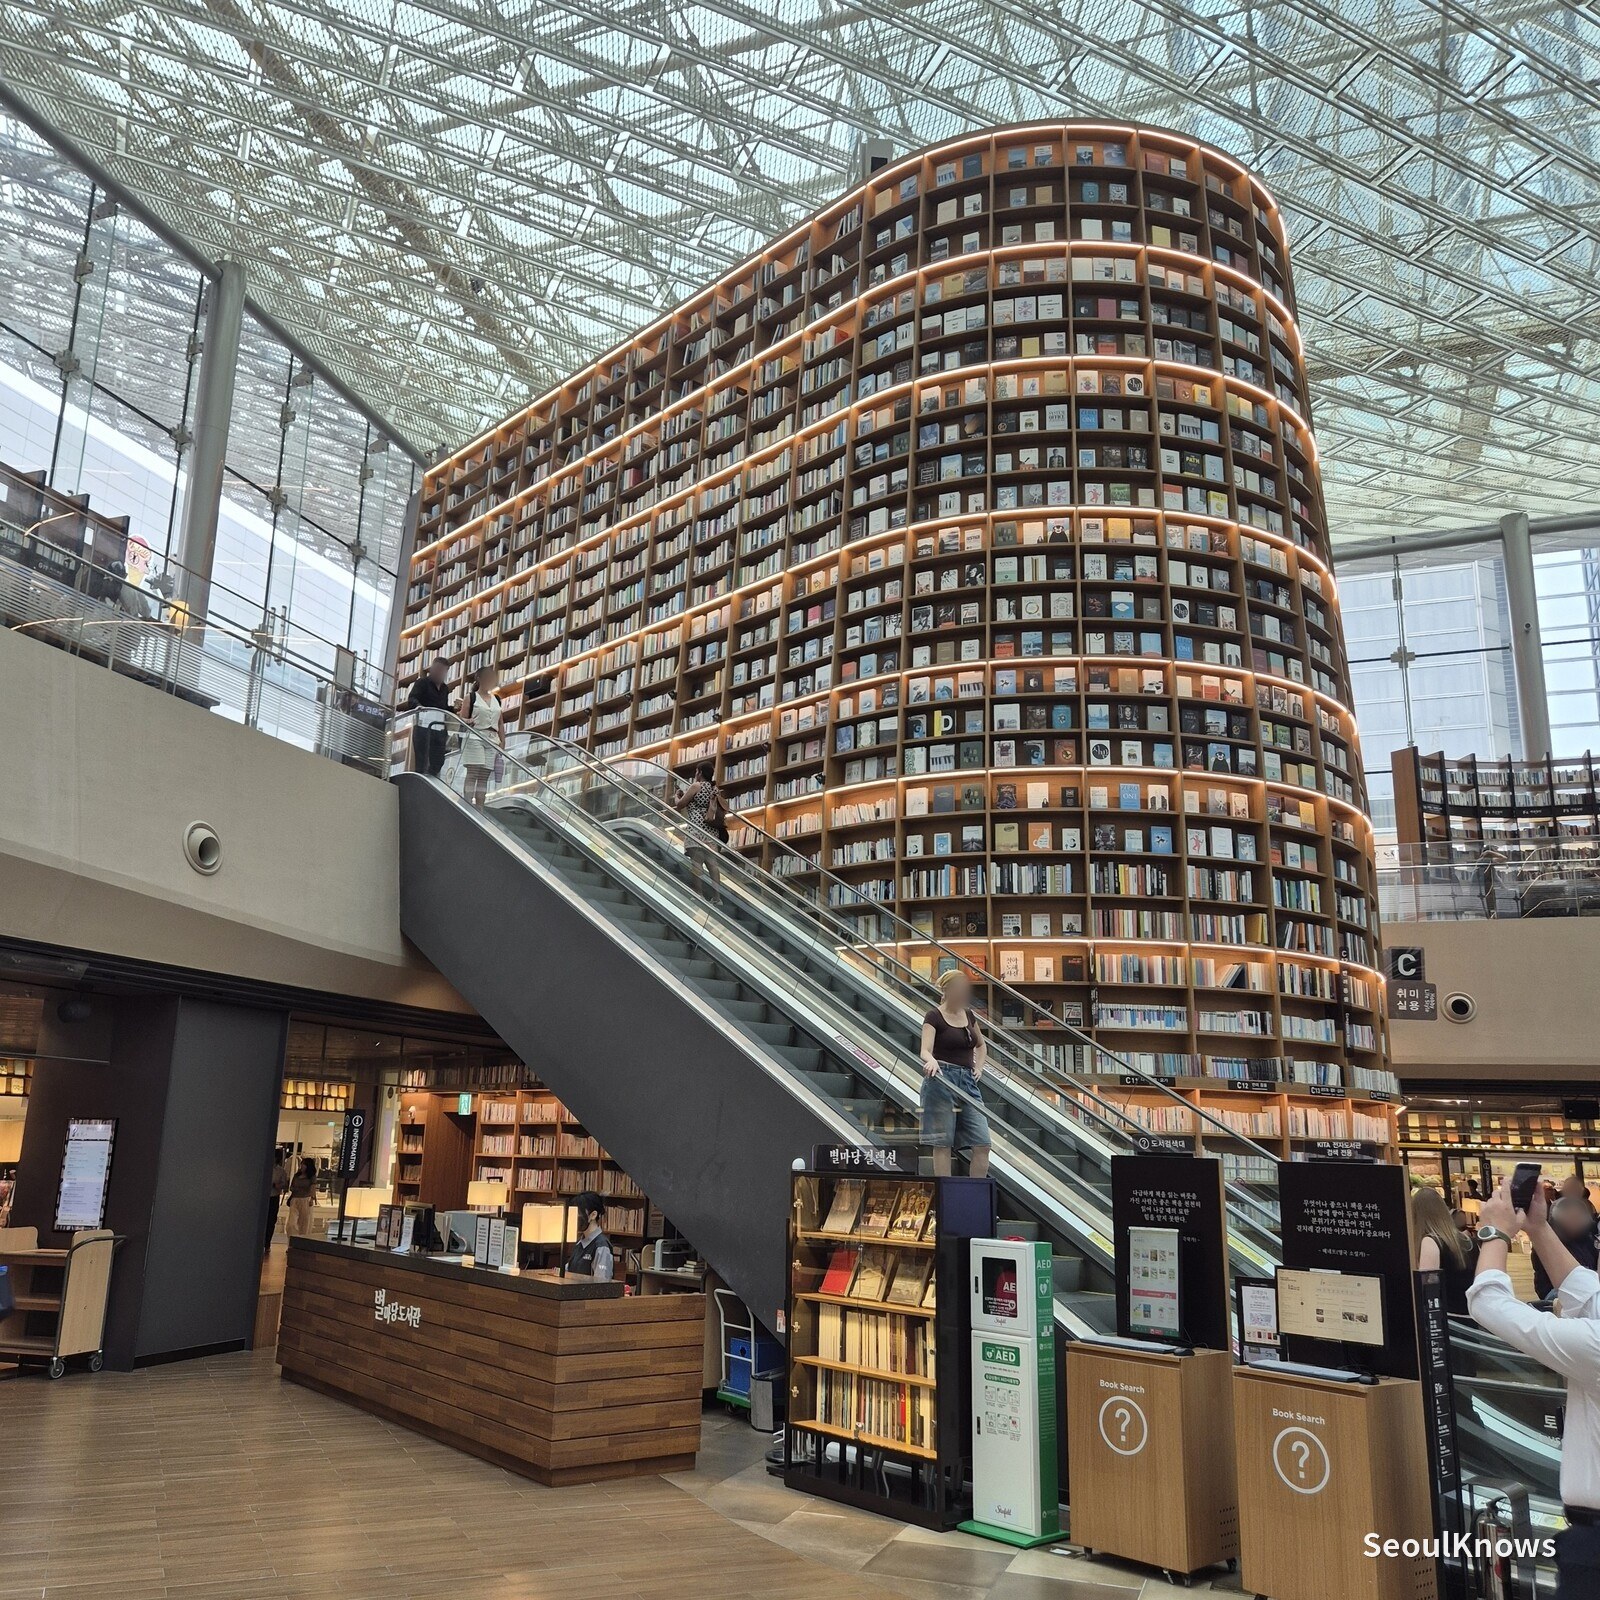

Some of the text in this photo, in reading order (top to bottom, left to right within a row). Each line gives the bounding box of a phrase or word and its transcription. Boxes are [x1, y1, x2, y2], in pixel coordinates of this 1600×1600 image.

[1397, 953, 1417, 976] C
[1397, 988, 1419, 999] 취미
[1397, 1000, 1420, 1011] 실용
[1236, 1081, 1249, 1090] C12
[1151, 1139, 1186, 1148] 도서검색대
[1332, 1141, 1361, 1149] 전자도서관
[349, 1128, 360, 1171] INFORMATION
[1326, 1149, 1353, 1157] 검색 전용
[829, 1148, 897, 1166] 별마당 컬렉션
[1155, 1190, 1166, 1198] 책을
[1171, 1199, 1182, 1207] 책을
[1303, 1199, 1327, 1208] 무엇이나
[1329, 1201, 1348, 1209] 좋으니
[1350, 1202, 1363, 1210] 책을
[1346, 1211, 1359, 1219] 두면
[1360, 1212, 1380, 1220] 독서의
[1311, 1217, 1336, 1226] 분위기가
[1337, 1219, 1357, 1227] 만들어
[1315, 1226, 1333, 1234] 같지만
[1365, 1230, 1391, 1239] 중요하다
[1036, 1259, 1052, 1269] AED
[1003, 1281, 1016, 1292] AE
[375, 1288, 421, 1328] 별마당도서관
[995, 1350, 1016, 1362] AED
[1099, 1379, 1145, 1394] Book Search
[1272, 1408, 1326, 1425] Book Search
